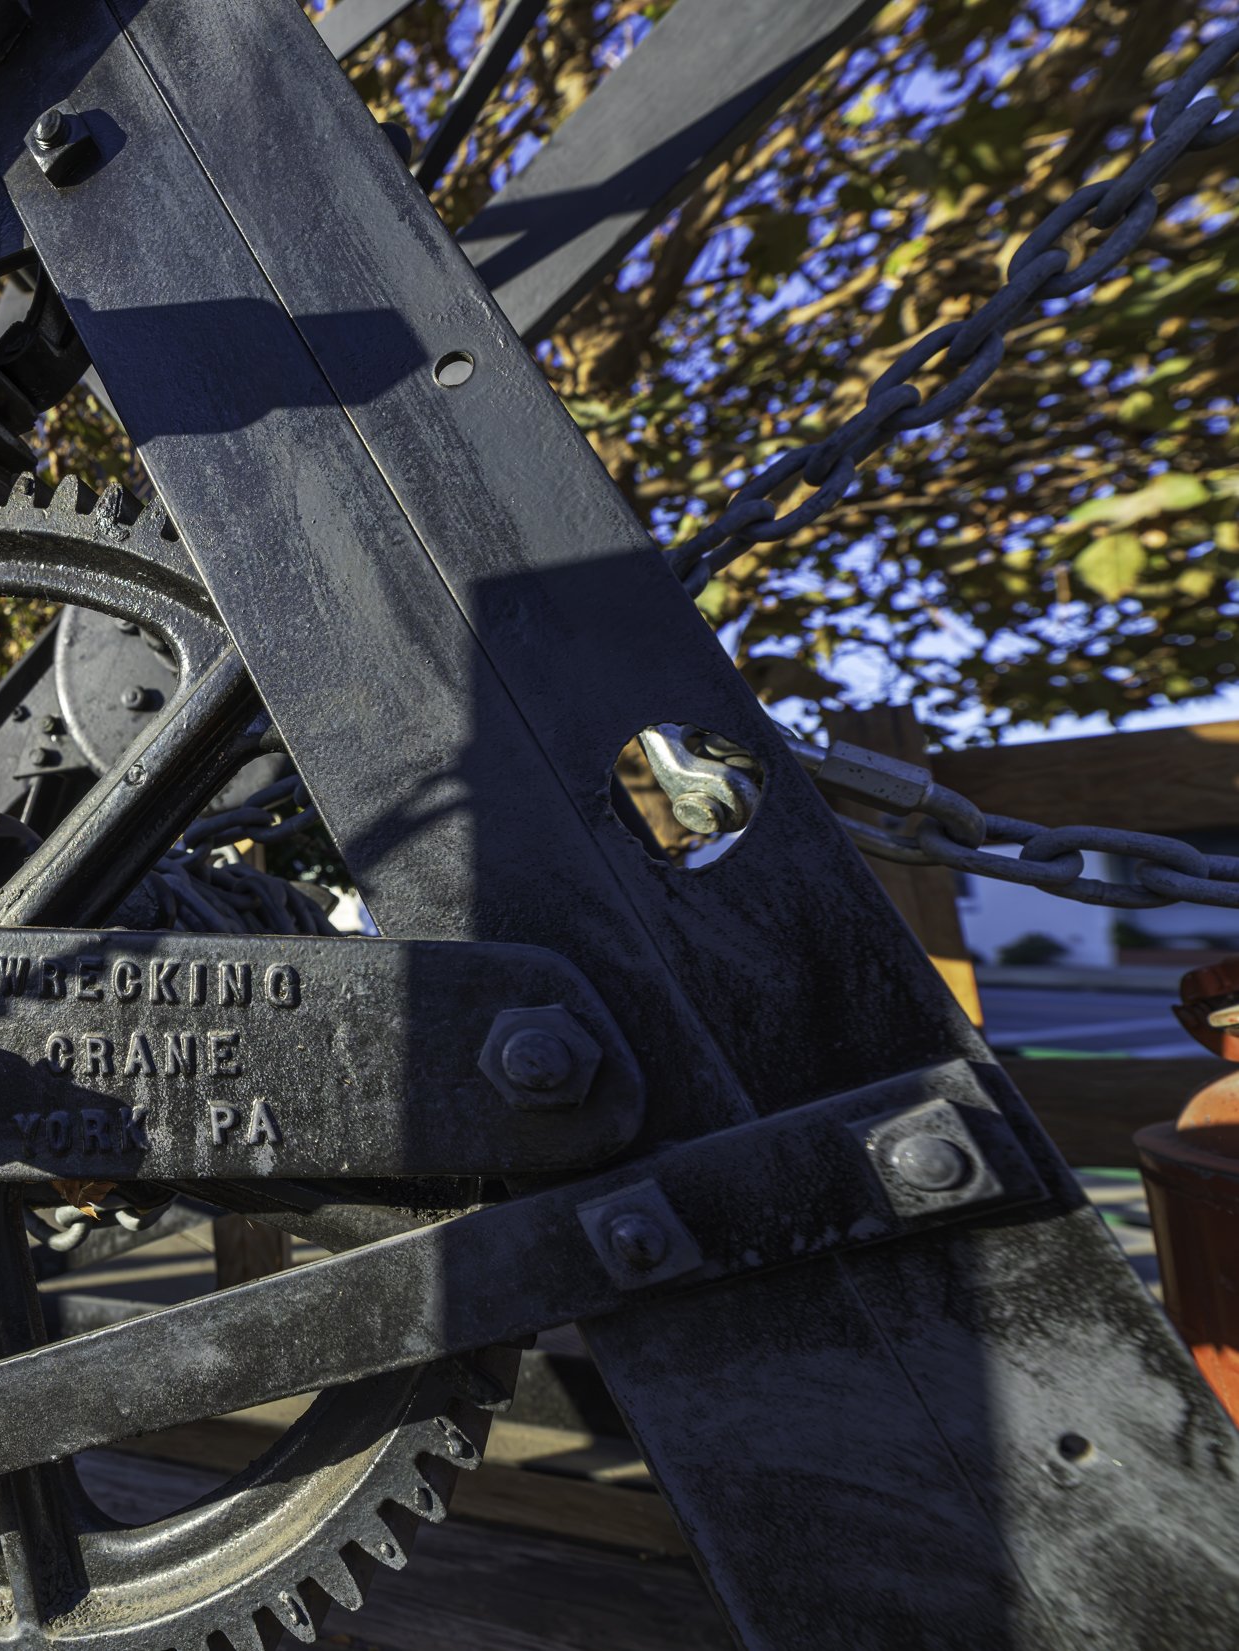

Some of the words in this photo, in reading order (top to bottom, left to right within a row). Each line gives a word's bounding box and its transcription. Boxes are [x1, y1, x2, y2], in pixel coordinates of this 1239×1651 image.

[45, 1030, 243, 1077] CRANE
[13, 1105, 150, 1158] YORK
[208, 1098, 283, 1146] PA
